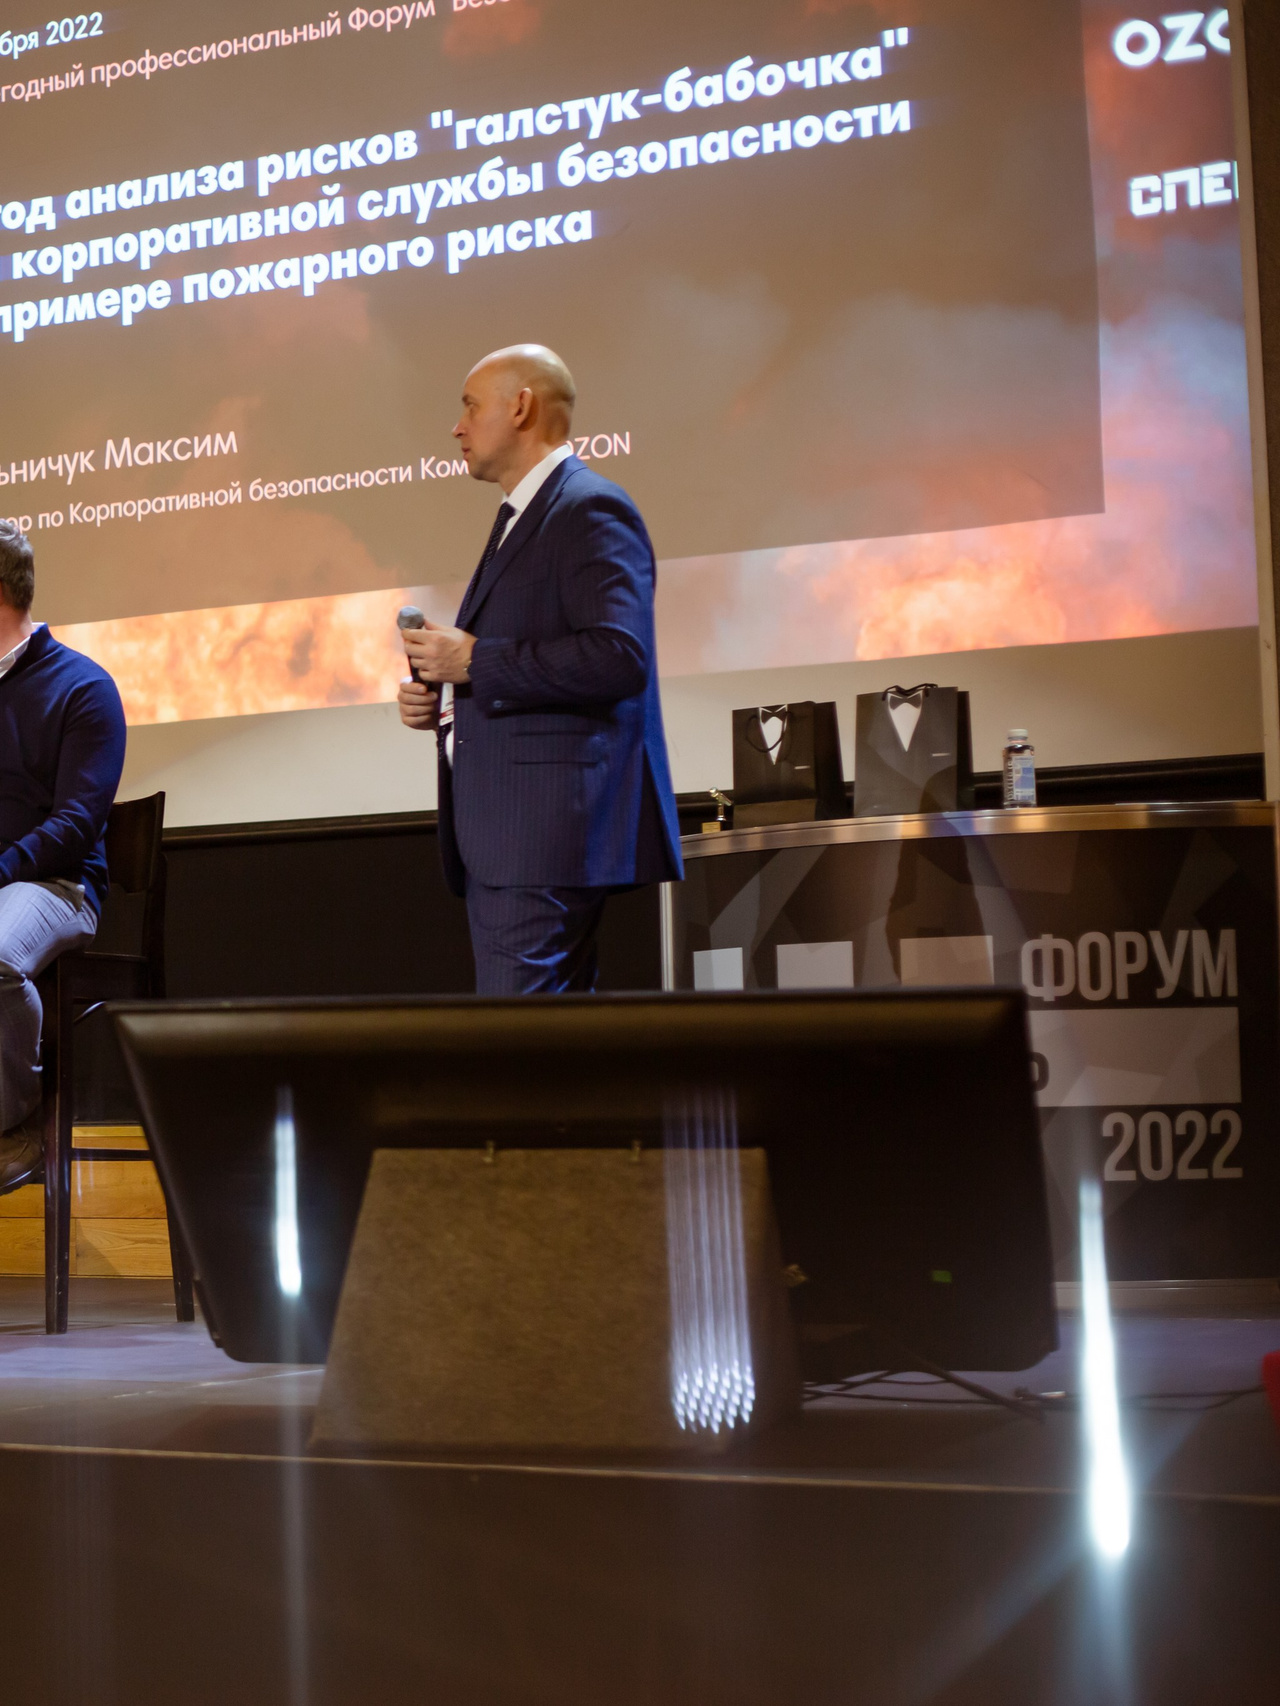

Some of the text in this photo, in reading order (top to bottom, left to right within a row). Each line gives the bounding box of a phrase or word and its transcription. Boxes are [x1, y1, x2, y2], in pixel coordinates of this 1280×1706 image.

[46, 12, 104, 46] 2022
[91, 12, 341, 87] профессиональный
[348, 0, 436, 32] Форум
[65, 159, 244, 218] анализа
[257, 129, 418, 196] рисков
[431, 27, 909, 149] "галстук-бабочка"
[12, 184, 345, 283] корпоративной
[357, 156, 543, 224] службы
[557, 100, 911, 188] безопасности
[1130, 160, 1239, 217] СПЕ
[183, 236, 434, 296] пожарного
[447, 210, 593, 274] риска
[104, 430, 238, 472] Максим
[38, 510, 64, 529] по
[69, 482, 242, 527] Корпоративной
[249, 460, 413, 504] безопасности
[421, 456, 469, 480] Ком
[1021, 929, 1238, 1001] ФОРУМ
[1102, 1109, 1243, 1181] 2022
